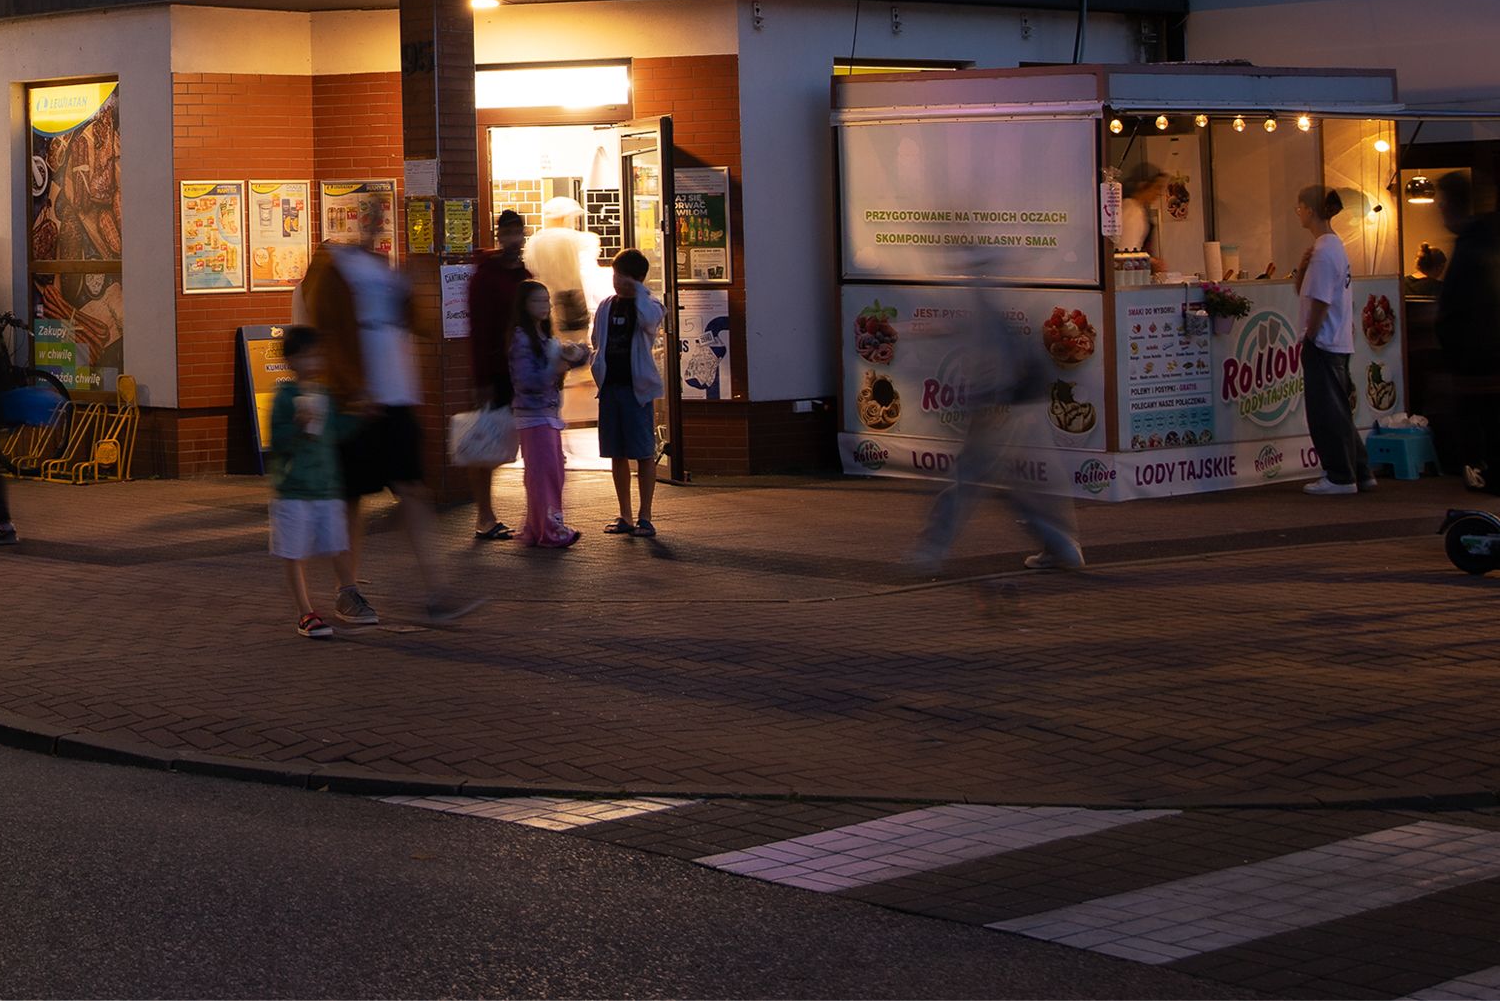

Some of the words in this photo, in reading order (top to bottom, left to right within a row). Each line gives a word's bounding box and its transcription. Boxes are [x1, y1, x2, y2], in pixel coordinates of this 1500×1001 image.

[674, 194, 686, 202] AJ
[865, 210, 951, 222] PRZYGOTOWANE
[955, 211, 970, 222] NA
[973, 212, 1017, 222] TWOICH
[1020, 212, 1068, 223] OCZACH
[875, 233, 941, 245] SKOMPONUJ
[944, 233, 974, 245] SWÓJ
[977, 235, 1022, 246] WŁASNY
[1025, 236, 1057, 247] SMAK
[913, 308, 939, 318] JEST
[38, 325, 68, 339] Zakupy
[38, 351, 46, 359] w
[47, 348, 73, 362] chwilę
[1222, 342, 1302, 401] Rollov
[75, 373, 101, 386] chwilę
[1240, 394, 1263, 416] LODY
[1266, 376, 1304, 406] TAJSKIE
[1135, 461, 1177, 486] LODY
[1177, 455, 1237, 480] TAJSKIE
[1300, 447, 1319, 468] LO
[1074, 467, 1117, 484] Rollove
